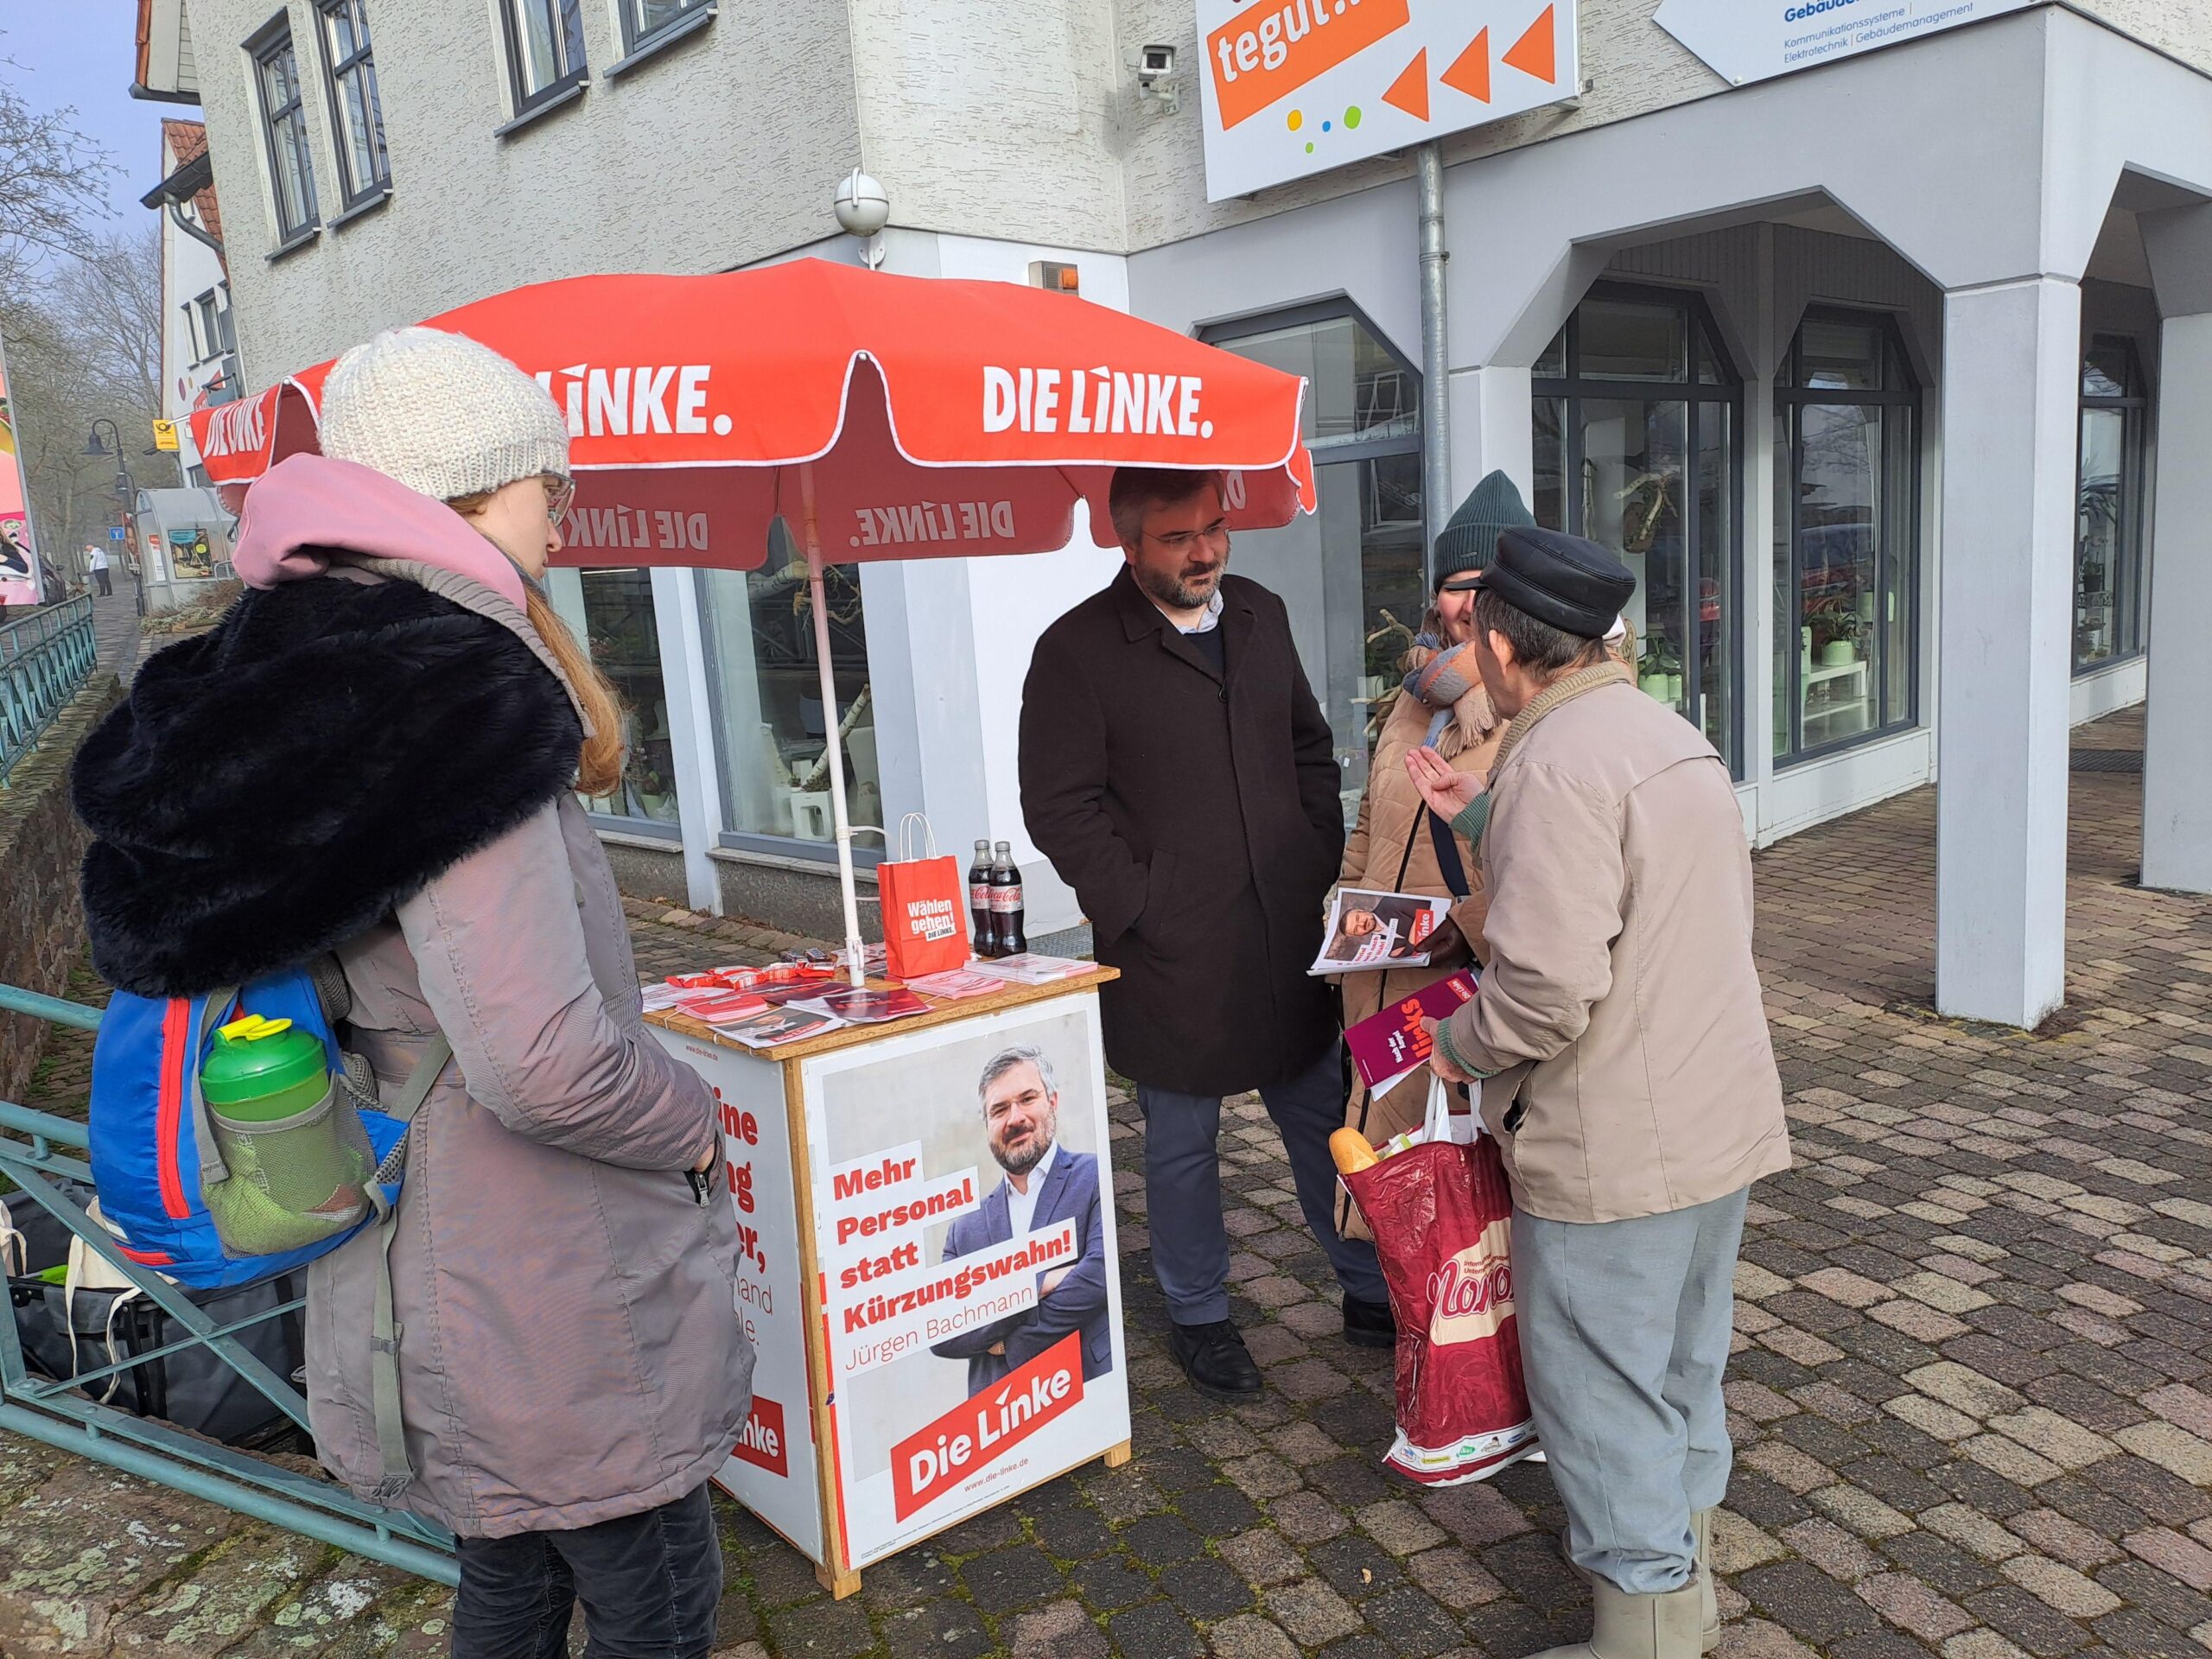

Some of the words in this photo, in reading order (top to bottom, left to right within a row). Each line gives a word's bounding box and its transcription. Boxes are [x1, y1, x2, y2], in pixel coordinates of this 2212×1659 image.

[1784, 6, 1905, 48] Kommunikationssysteme
[1784, 38, 1847, 63] Elektrotechnik
[1856, 3, 1974, 43] Gebäudemanagement
[983, 365, 1060, 432] DIE
[1067, 365, 1213, 439] LINKE.
[203, 404, 236, 458] DIE
[907, 899, 952, 918] Wählen
[911, 912, 955, 934] gehen!
[1418, 913, 1430, 938] inke
[928, 931, 938, 939] DIE
[1388, 1037, 1397, 1048] der
[1402, 998, 1433, 1058] links
[1392, 1047, 1404, 1064] Nach
[713, 1086, 758, 1146] ine
[727, 1160, 754, 1214] ng
[833, 1158, 916, 1201] Mehr
[836, 1178, 974, 1246] Personal
[736, 1221, 766, 1274] er,
[840, 1241, 918, 1289] statt
[843, 1230, 1070, 1333] Kürzungswahn!
[845, 1331, 918, 1370] Jürgen
[926, 1287, 1033, 1340] Bachmann
[739, 1413, 779, 1459] nke
[910, 1434, 972, 1496] Die
[977, 1369, 1071, 1451] Linke
[963, 1457, 1028, 1493] www.die-linke.de
